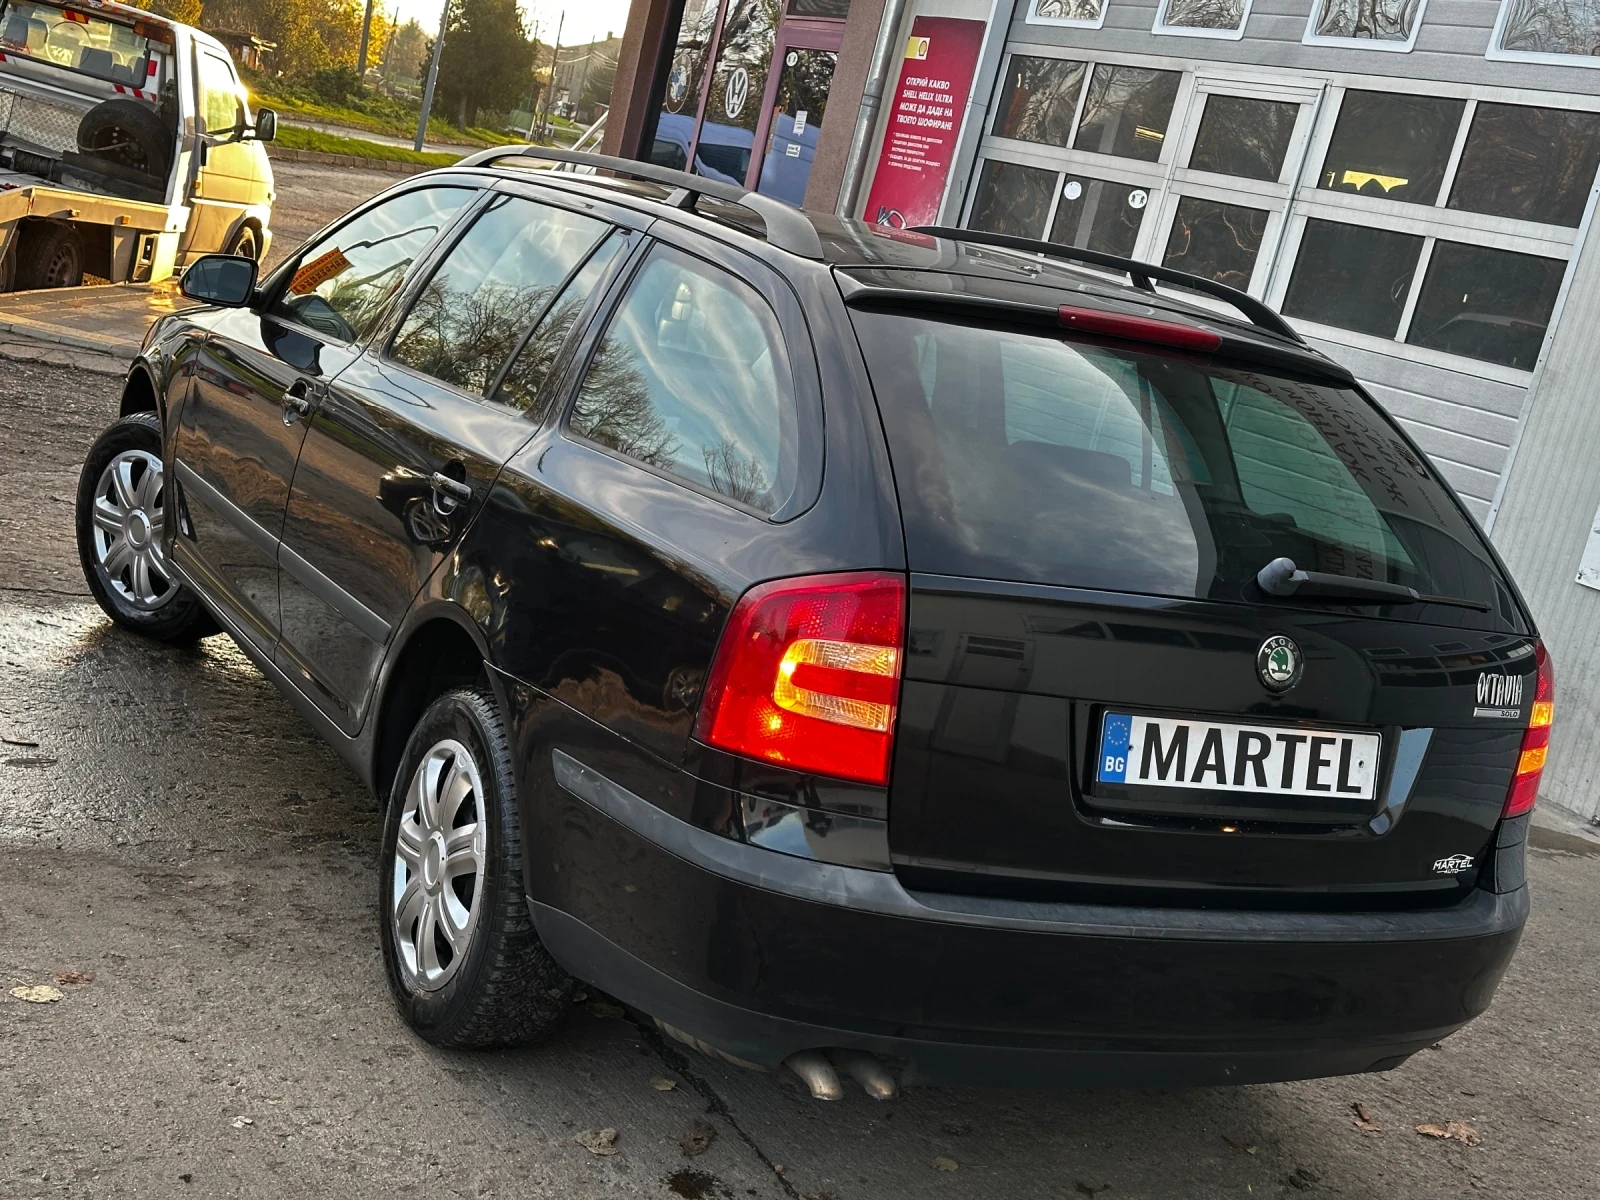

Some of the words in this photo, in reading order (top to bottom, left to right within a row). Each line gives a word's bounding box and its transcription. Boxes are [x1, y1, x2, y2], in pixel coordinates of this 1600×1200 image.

[906, 77, 928, 87] ОТКРИЙ
[928, 79, 950, 90] КАКВО
[903, 90, 917, 98] SHELL
[919, 92, 934, 101] HELIX
[935, 93, 953, 104] ULTRA
[900, 102, 917, 111] МОЖЕ
[916, 104, 926, 114] ДА
[926, 106, 943, 116] ДАДЕ
[944, 108, 953, 117] НА
[897, 114, 917, 124] ТВОЕТО
[918, 118, 953, 130] ШОФИРАНЕ
[1477, 672, 1523, 706] OCTAVIA
[1500, 710, 1518, 718] SOLO
[1105, 755, 1125, 773] BG
[1139, 722, 1362, 794] MARTEL
[1432, 859, 1473, 871] MARTEL
